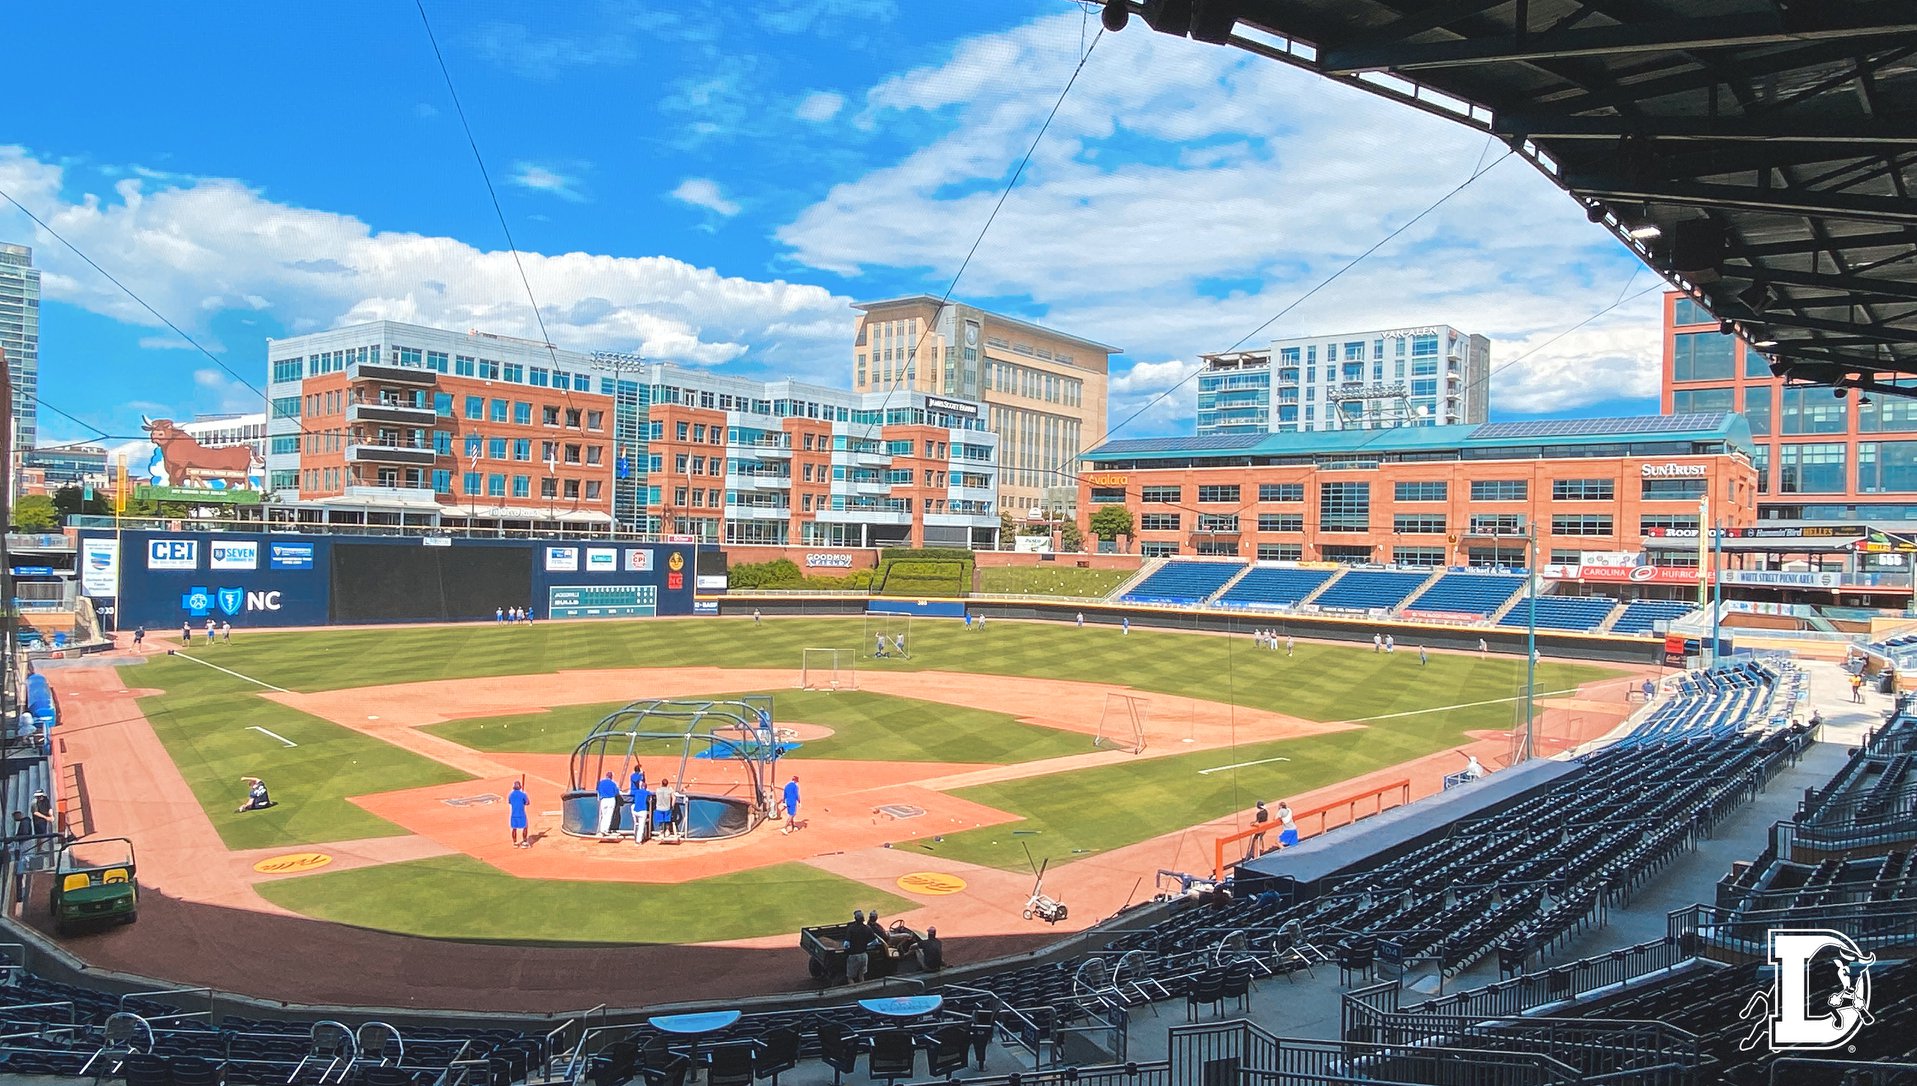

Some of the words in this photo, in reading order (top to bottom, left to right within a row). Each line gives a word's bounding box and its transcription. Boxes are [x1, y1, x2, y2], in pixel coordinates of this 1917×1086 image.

[1381, 329, 1404, 339] VAN
[1409, 326, 1438, 337] ALEN
[1088, 473, 1129, 486] Avalara
[1665, 528, 1725, 538] ROOFOP
[1803, 527, 1833, 537] HELLES
[151, 541, 194, 560] CEI
[226, 547, 255, 558] SEVEN
[806, 553, 852, 561] GOODMON
[1464, 566, 1490, 575] Michael
[1490, 566, 1497, 575] &
[1498, 566, 1511, 575] Son
[1583, 568, 1626, 577] CAROLINA
[1661, 570, 1716, 579] HURRICAES
[1740, 572, 1759, 582] WHITE
[1760, 572, 1779, 583] STREET
[1779, 573, 1799, 584] PICNIC
[1799, 574, 1815, 584] AREA
[247, 591, 281, 611] NC
[1381, 945, 1398, 957] 104
